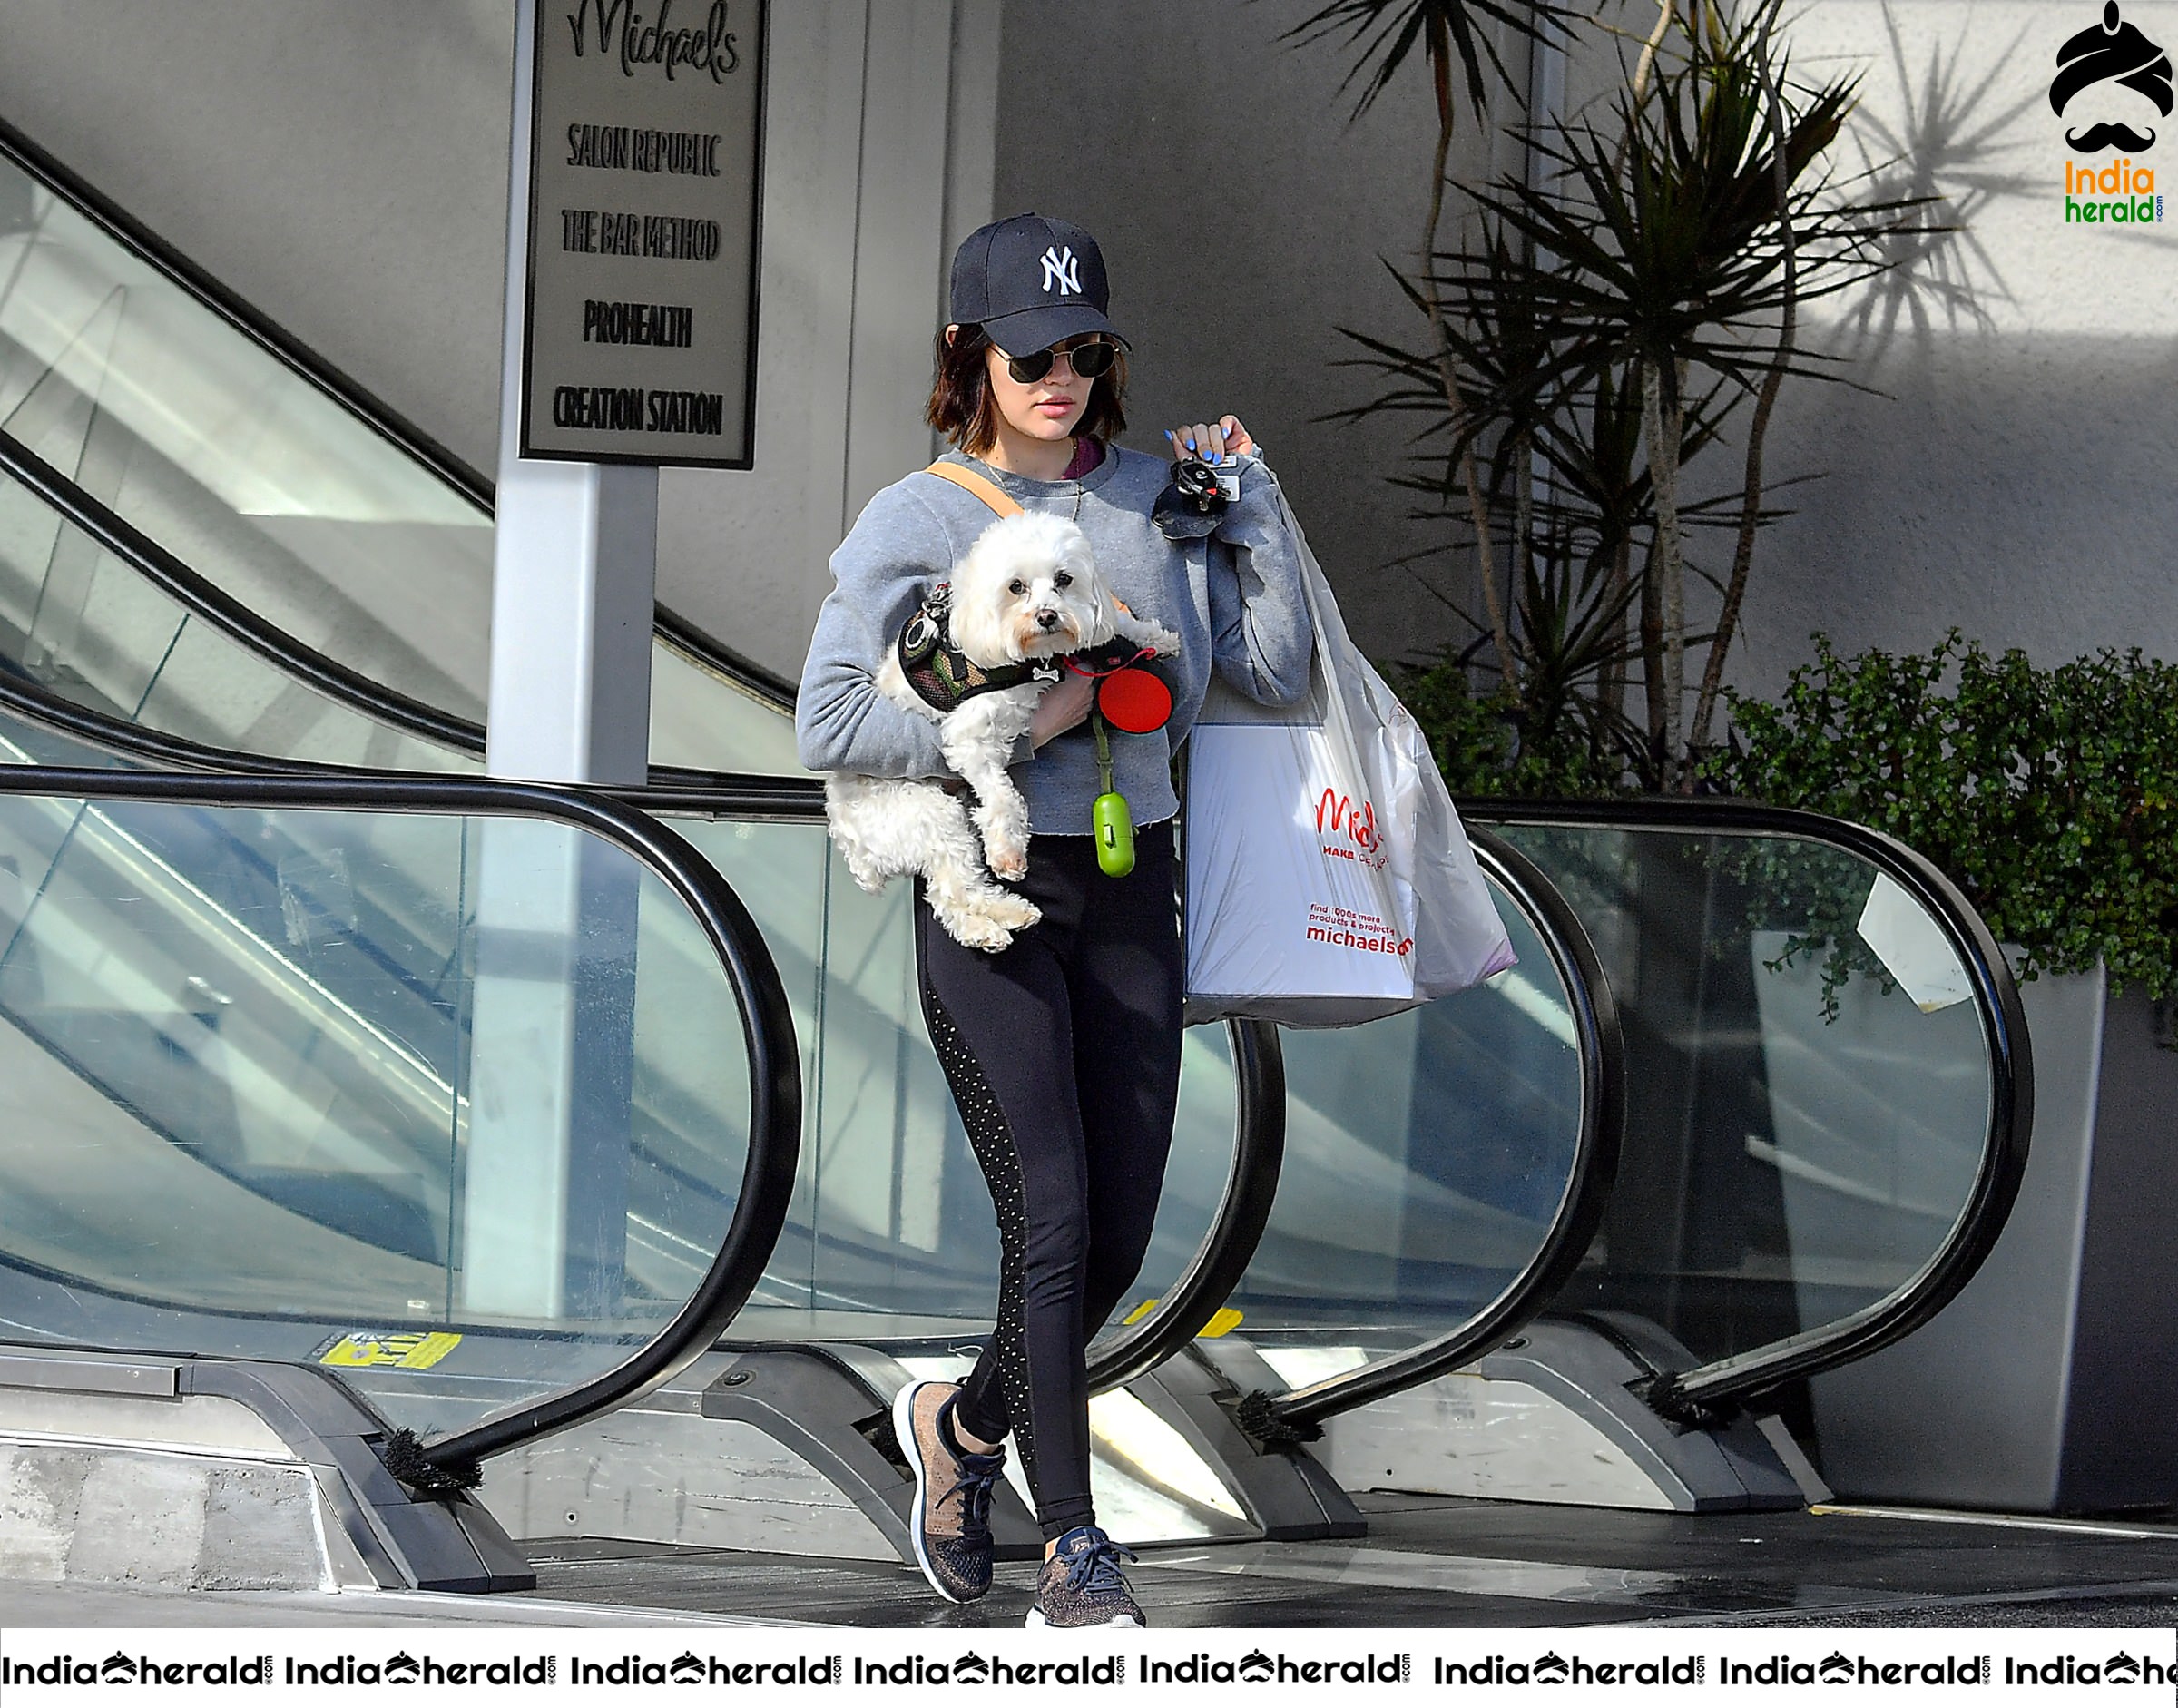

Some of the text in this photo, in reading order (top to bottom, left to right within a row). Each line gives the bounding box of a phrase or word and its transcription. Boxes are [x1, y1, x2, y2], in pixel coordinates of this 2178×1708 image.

[566, 0, 739, 85] Michaels
[566, 123, 722, 178] SALON REPUBLIC
[561, 209, 722, 261] THE BAR METHOD
[1039, 246, 1083, 296] NY
[584, 299, 693, 348] PROHEALTH
[553, 385, 724, 436] CREATION STATION
[1322, 845, 1355, 860] MAKE
[1309, 913, 1349, 928] products
[1350, 919, 1357, 928] &
[1310, 903, 1329, 914] find
[1359, 913, 1381, 924] more
